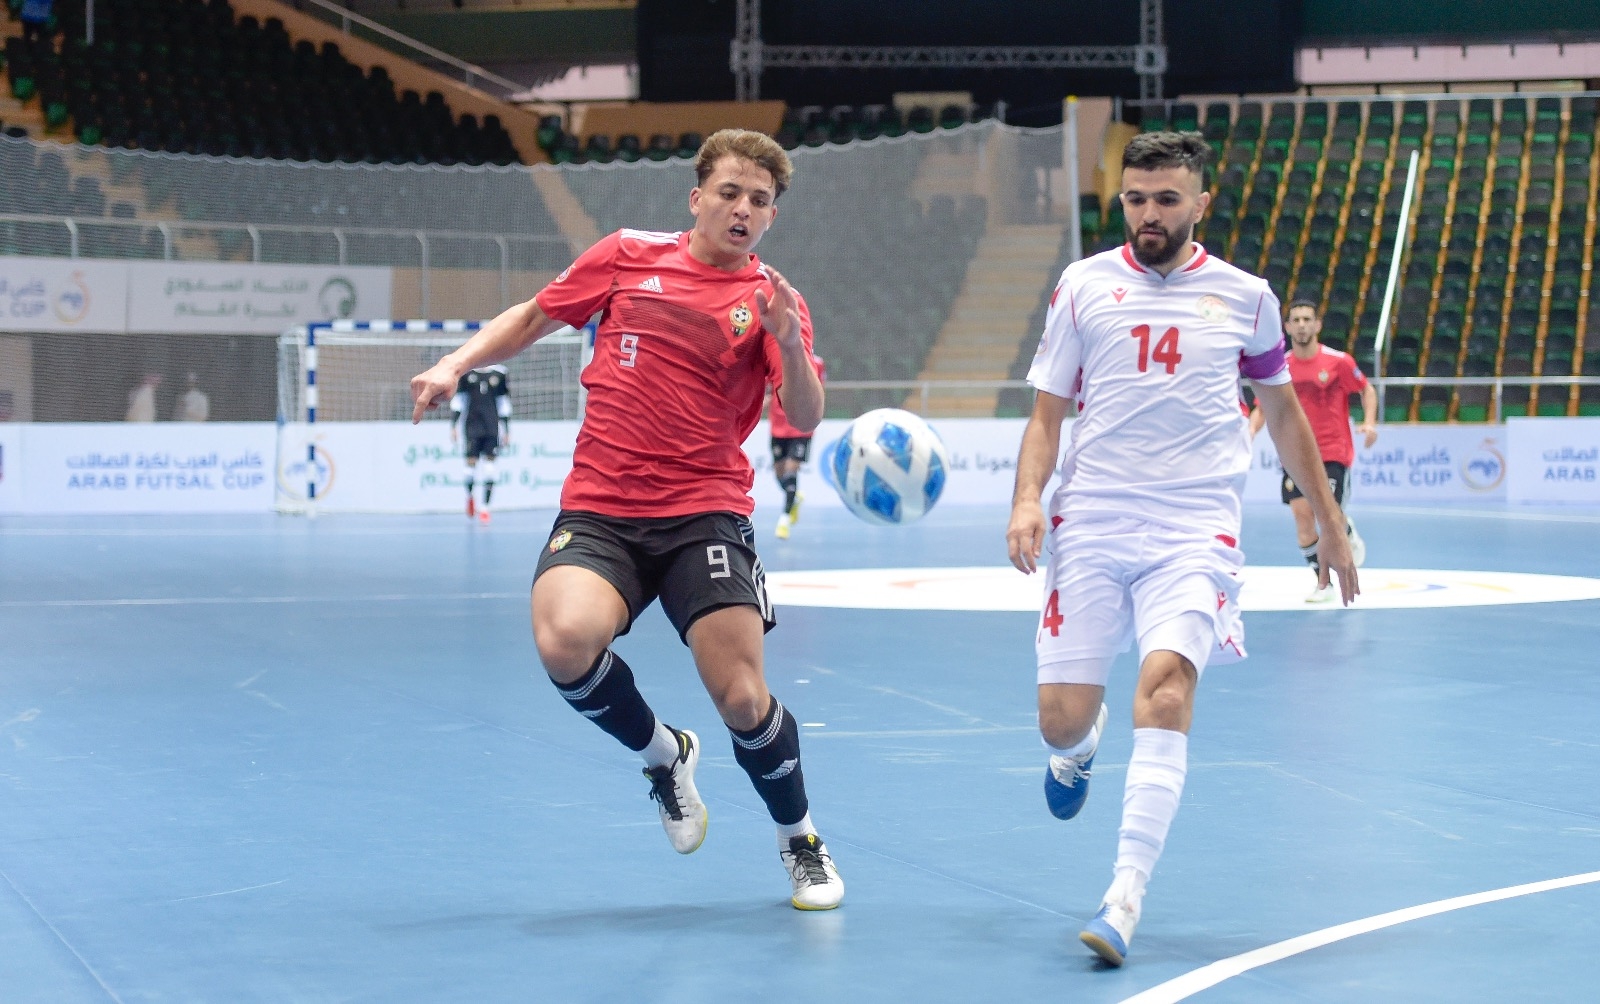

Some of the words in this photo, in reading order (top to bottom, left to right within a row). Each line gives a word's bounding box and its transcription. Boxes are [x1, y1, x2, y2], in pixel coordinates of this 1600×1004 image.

[619, 333, 639, 368] 9
[1131, 324, 1182, 375] 14
[221, 451, 263, 472] كأس
[1408, 446, 1450, 467] كأس
[68, 474, 128, 489] ARAB
[135, 474, 215, 489] FUTSAL
[222, 474, 265, 489] CUP
[1408, 469, 1452, 486] CUP
[1544, 466, 1596, 482] ARAB
[706, 545, 731, 579] 9
